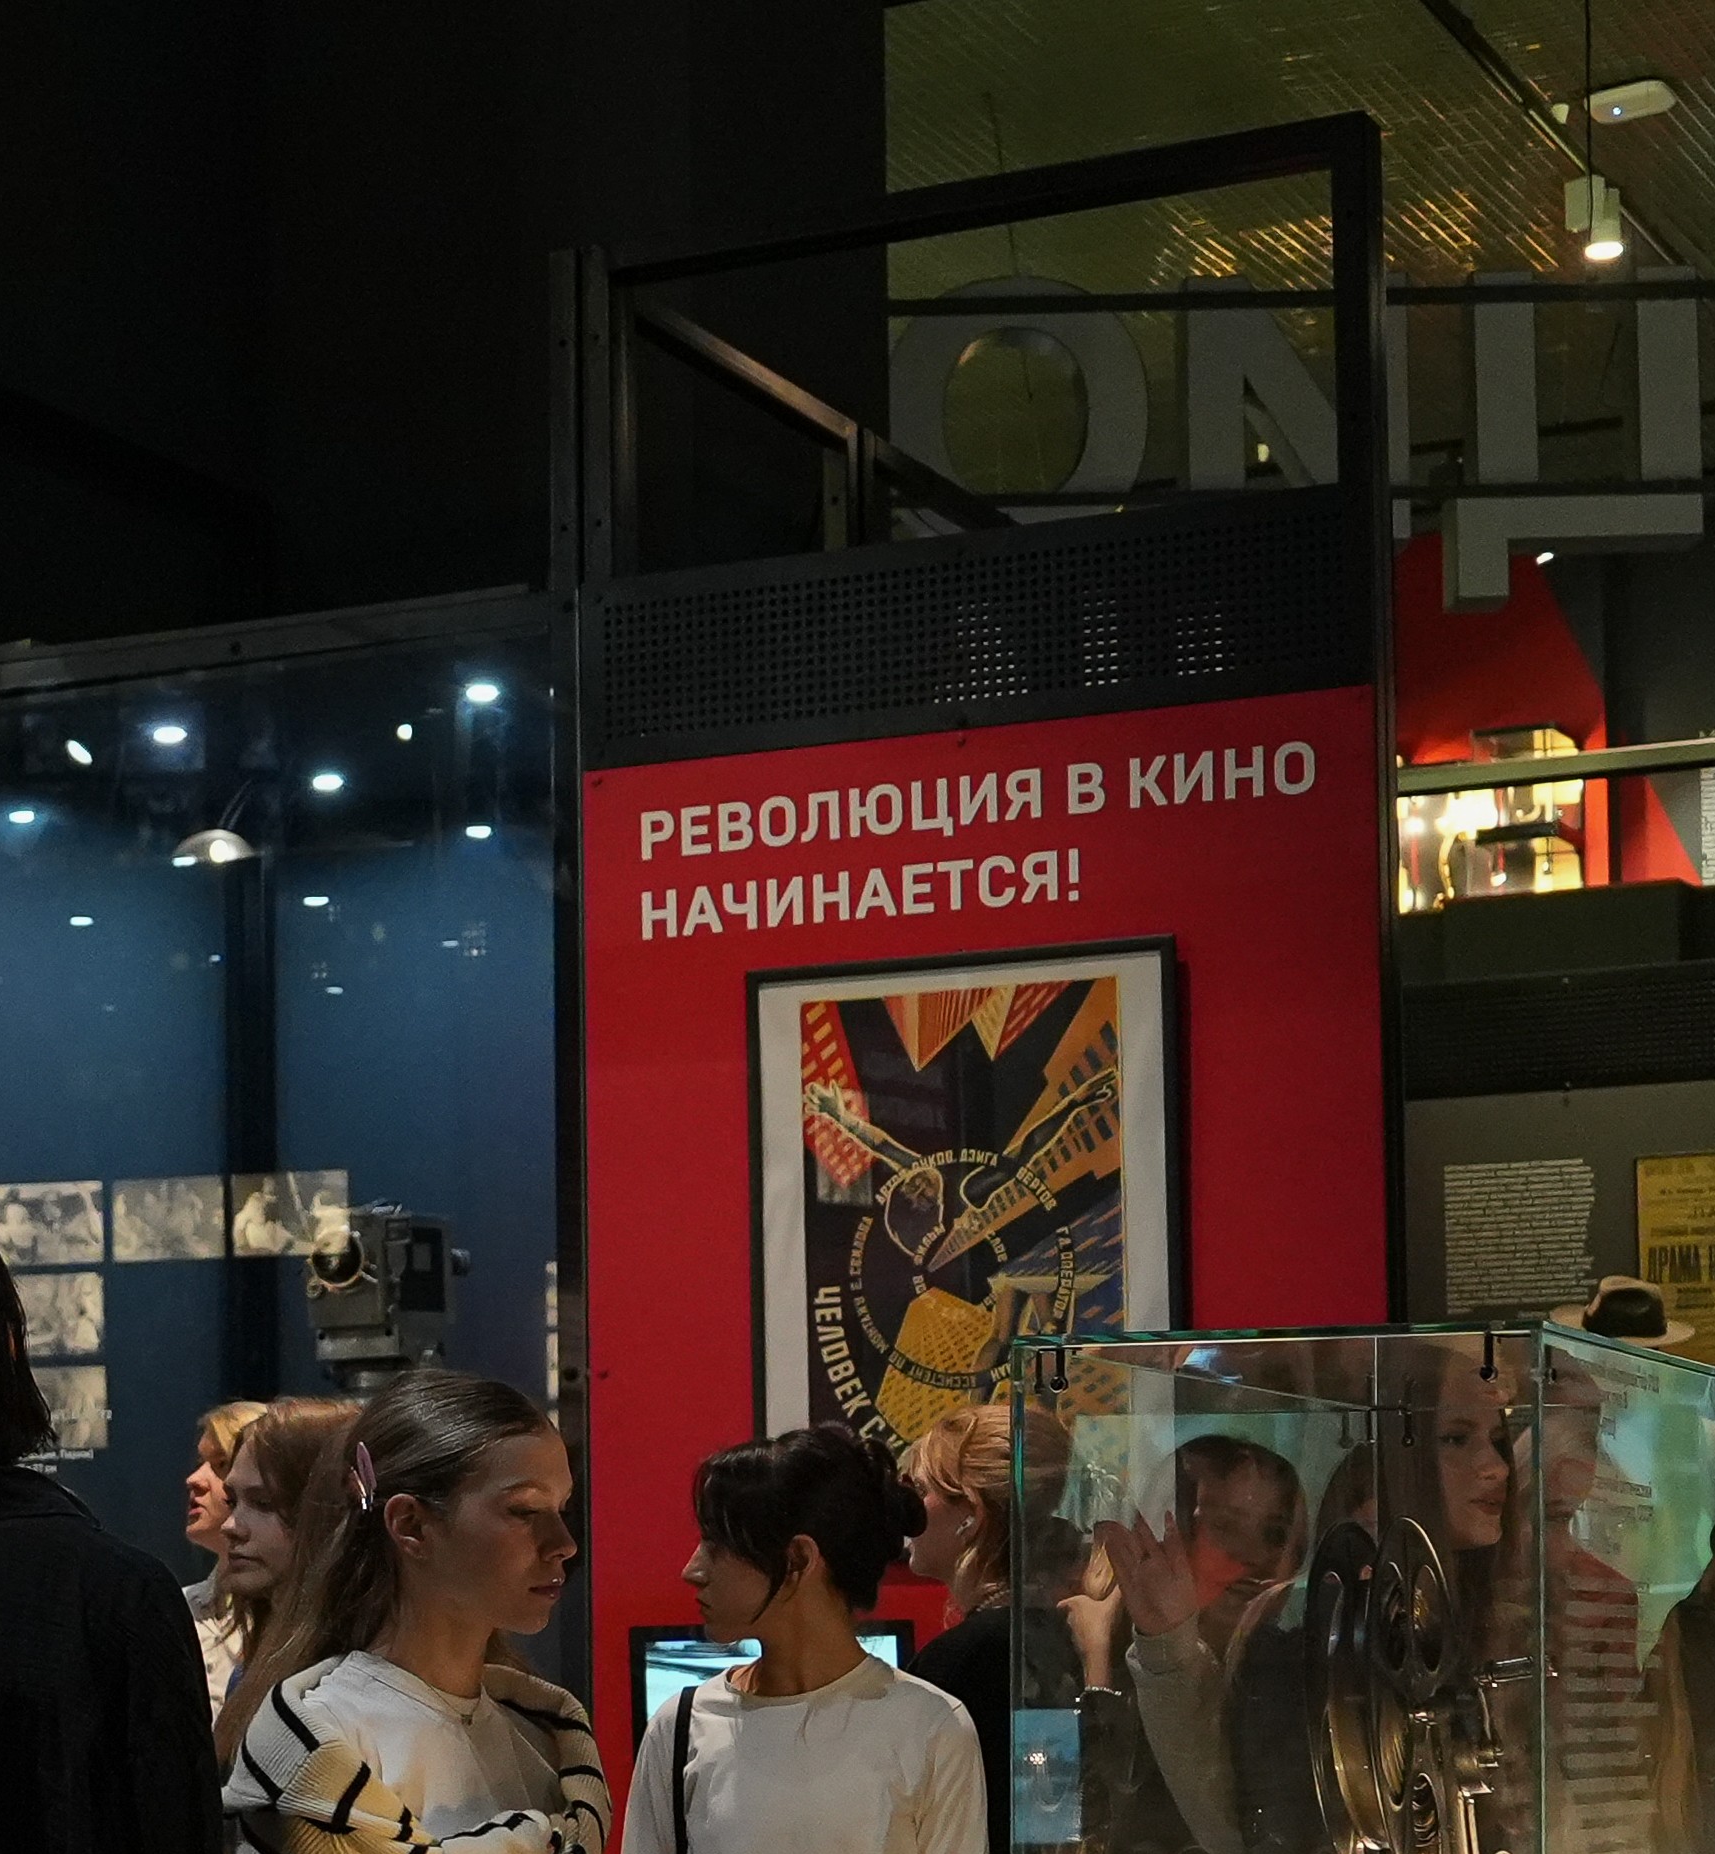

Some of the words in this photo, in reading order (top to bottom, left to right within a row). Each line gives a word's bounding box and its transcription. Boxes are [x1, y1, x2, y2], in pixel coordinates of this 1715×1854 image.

[640, 767, 1042, 861] РЕВОЛЮЦИЯ
[1067, 762, 1105, 816] В
[1129, 740, 1317, 808] КИНО
[640, 849, 1080, 941] НАЧИНАЕТСЯ!
[814, 1285, 872, 1420] ЧЕЛОВЕК
